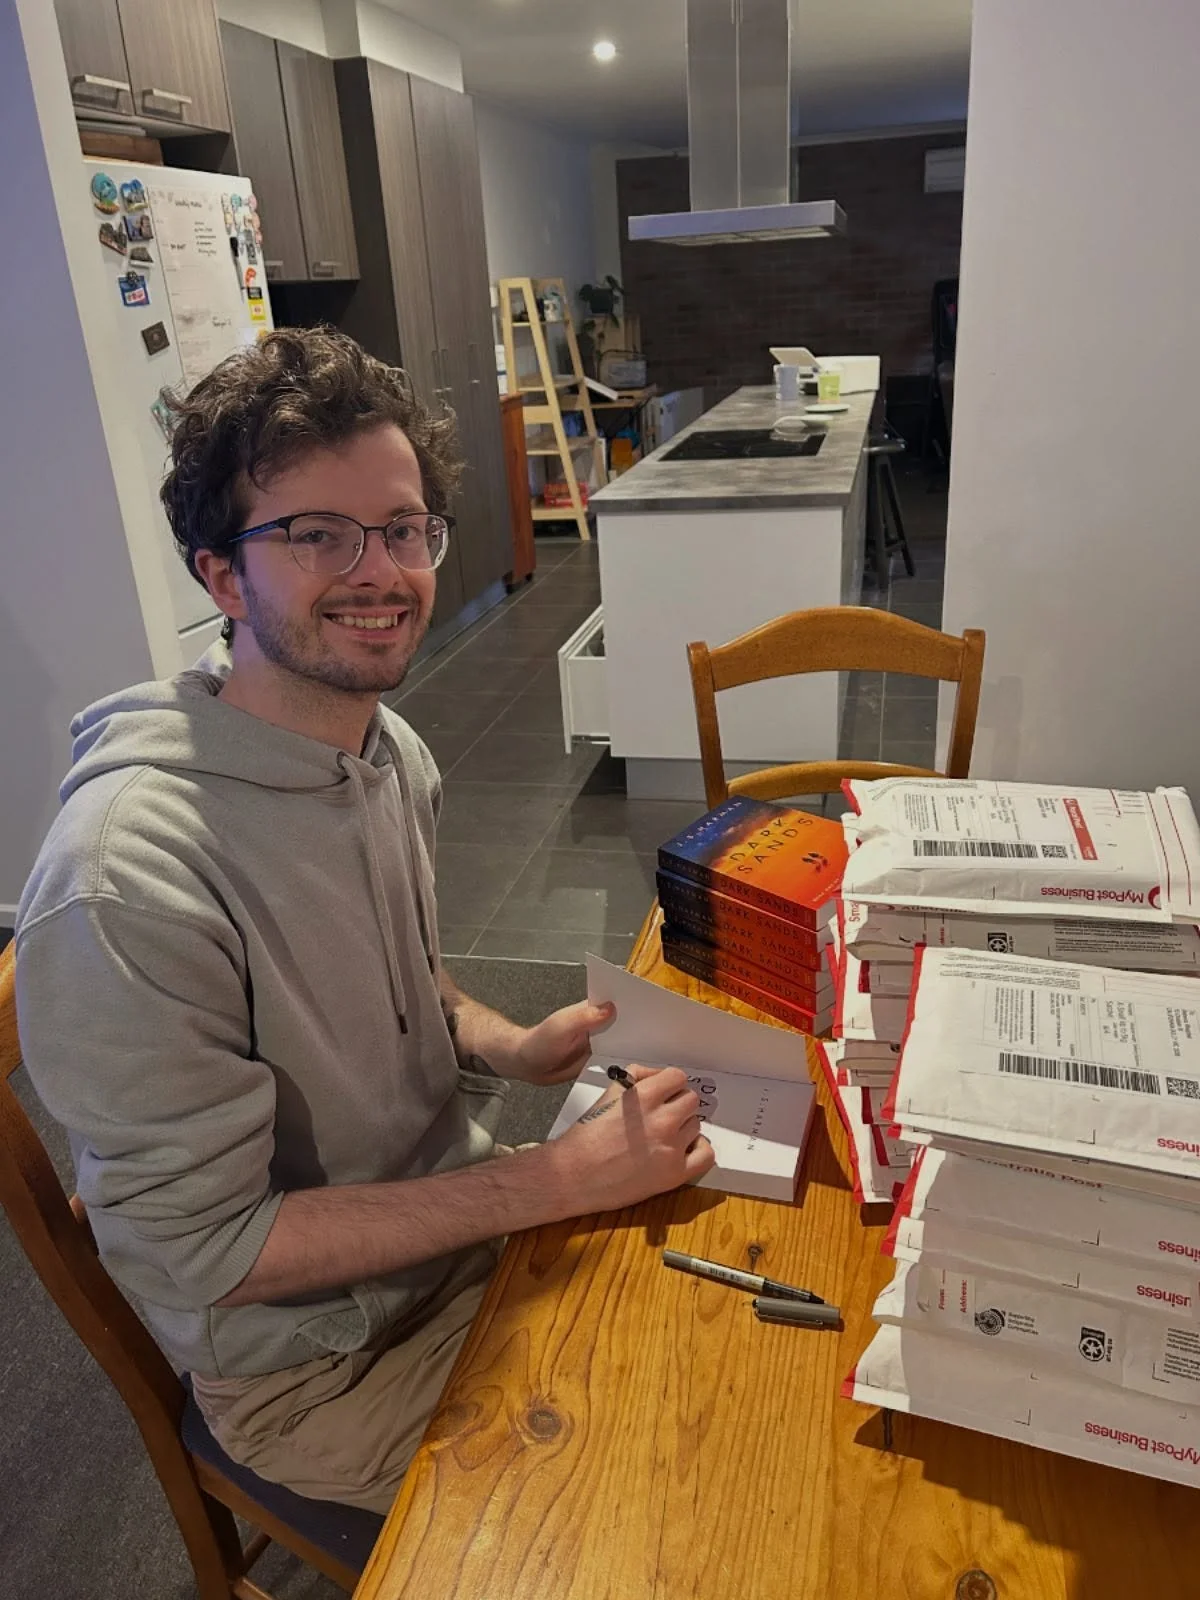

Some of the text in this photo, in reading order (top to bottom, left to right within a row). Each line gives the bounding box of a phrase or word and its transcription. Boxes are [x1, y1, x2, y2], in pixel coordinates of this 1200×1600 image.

[729, 815, 784, 862] DARK
[737, 817, 814, 874] SANDS
[720, 877, 750, 898] DARK
[758, 892, 798, 917] SANDS
[1040, 887, 1144, 904] MyPost Business
[719, 901, 750, 921] DARK
[756, 915, 799, 940] SANDS
[722, 921, 754, 941] DARK
[760, 936, 804, 962] SANDS
[722, 936, 800, 980] DARK SANDS
[721, 958, 752, 980] DARK
[758, 976, 800, 1001] SANDS
[721, 978, 751, 998] DARK
[757, 994, 798, 1021] SANDS
[696, 1084, 717, 1122] DAR
[1084, 1421, 1149, 1452] Business
